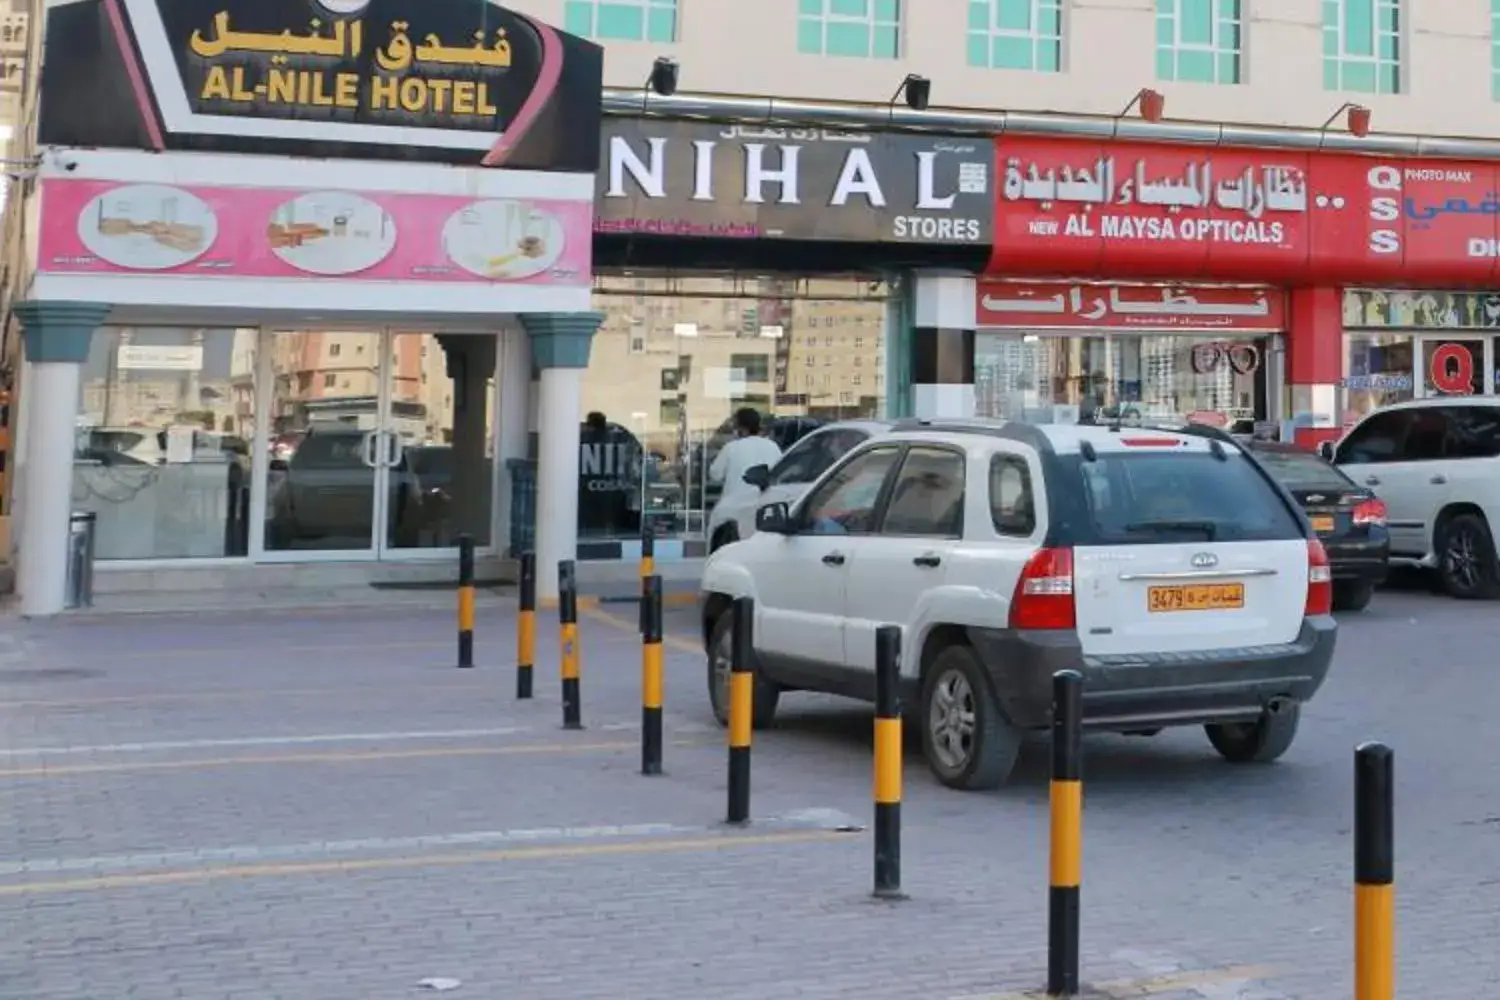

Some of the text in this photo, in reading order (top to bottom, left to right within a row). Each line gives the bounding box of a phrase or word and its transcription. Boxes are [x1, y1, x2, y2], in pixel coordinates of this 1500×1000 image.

[190, 10, 512, 70] فندق النيل
[201, 66, 497, 115] AL-NILE HOTEL
[605, 136, 956, 209] NIHAL
[1004, 155, 1114, 212] الجديدة
[1115, 157, 1212, 213] الميساء
[1216, 164, 1306, 218] نظارات
[1404, 168, 1473, 183] PHOTO MAX
[893, 216, 981, 241] STORES
[1028, 213, 1284, 244] NEW AL MAYSA OPTICALS
[982, 285, 1269, 320] نظارات
